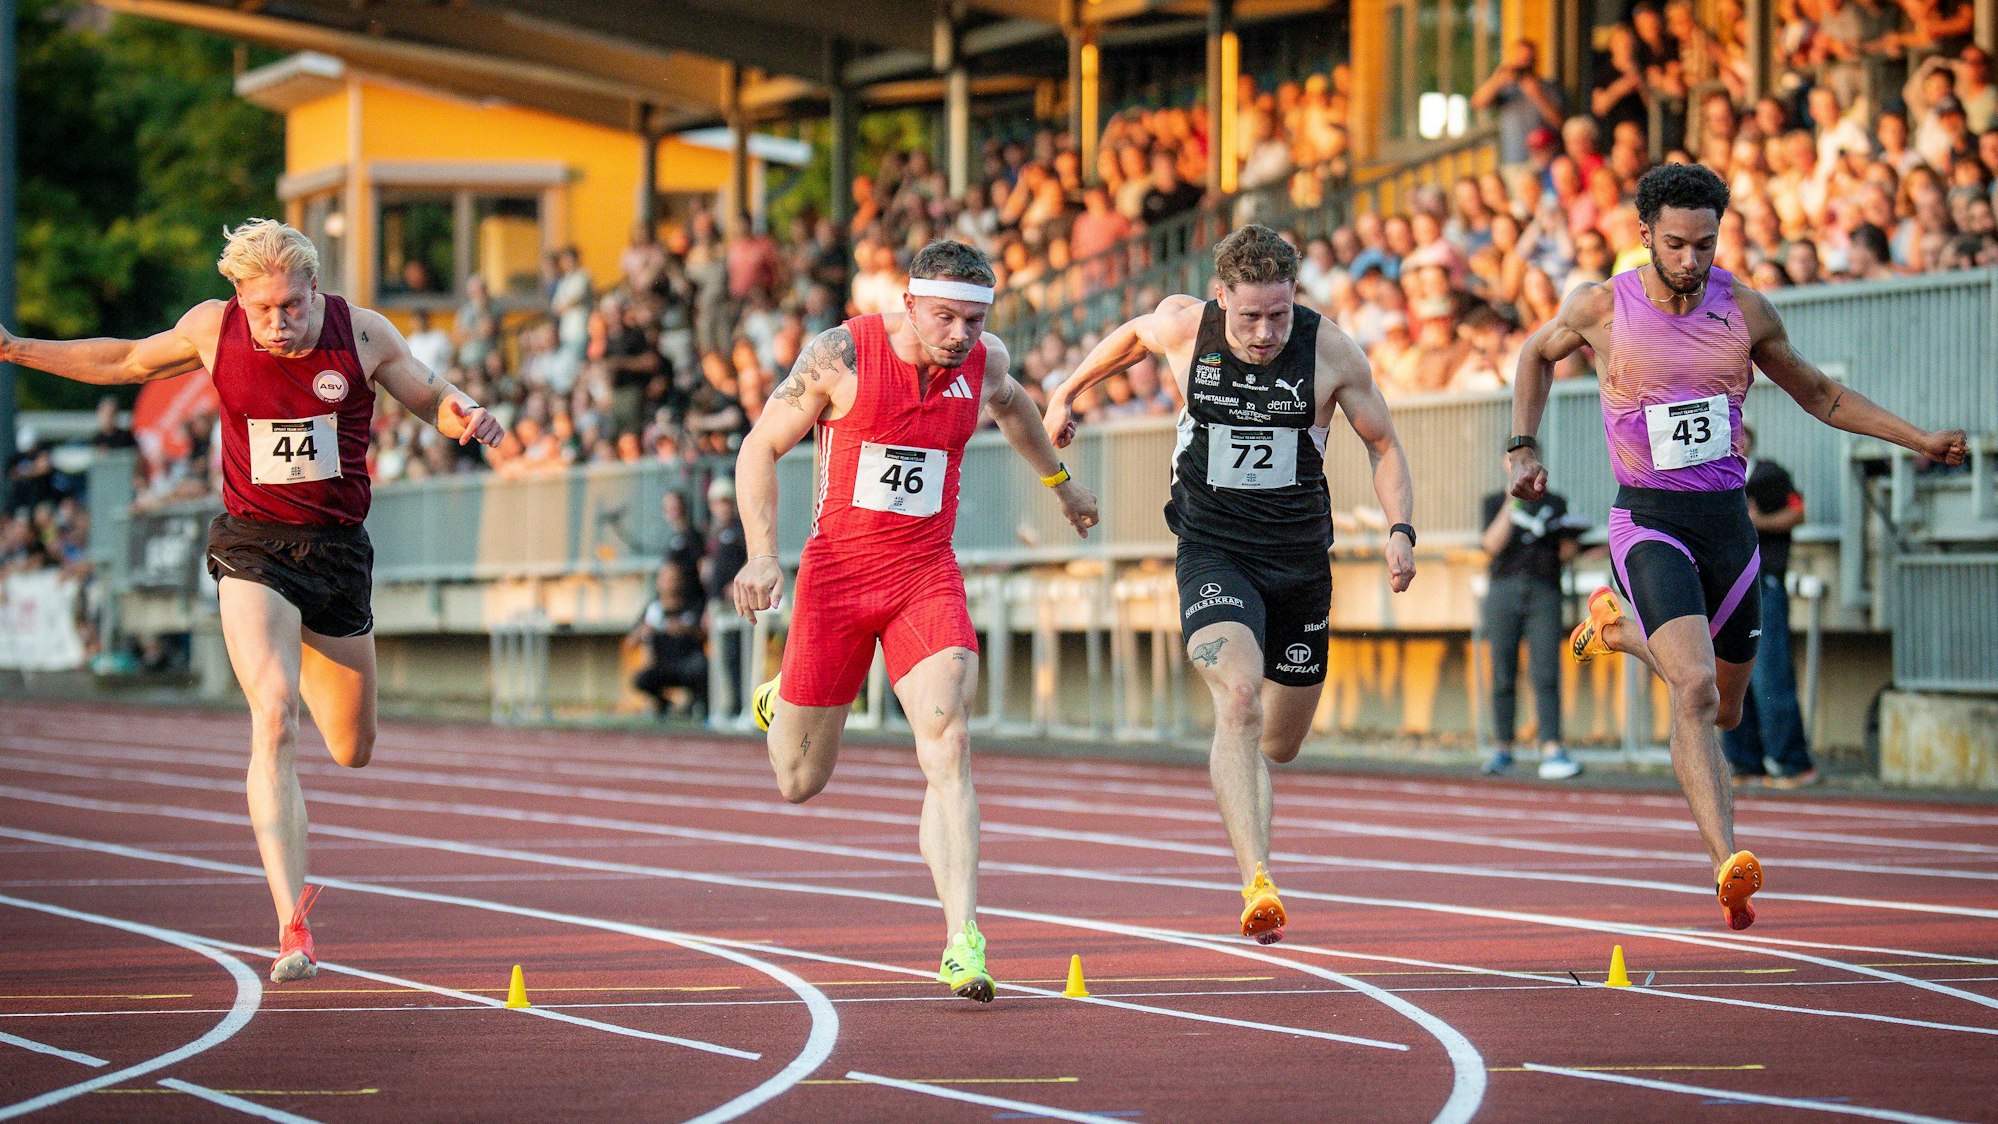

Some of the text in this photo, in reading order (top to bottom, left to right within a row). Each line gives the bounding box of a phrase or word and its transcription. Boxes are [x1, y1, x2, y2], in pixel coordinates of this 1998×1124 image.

[1196, 364, 1221, 374] SPRINT
[1195, 370, 1221, 381] TEAM
[319, 383, 343, 391] ASV
[1194, 377, 1220, 387] Wetzlar
[1231, 381, 1270, 392] Bundeswehr
[1672, 416, 1712, 446] 43
[273, 435, 318, 463] 44
[1231, 443, 1273, 469] 72
[880, 464, 924, 494] 46
[1275, 662, 1320, 674] WETZLAR
